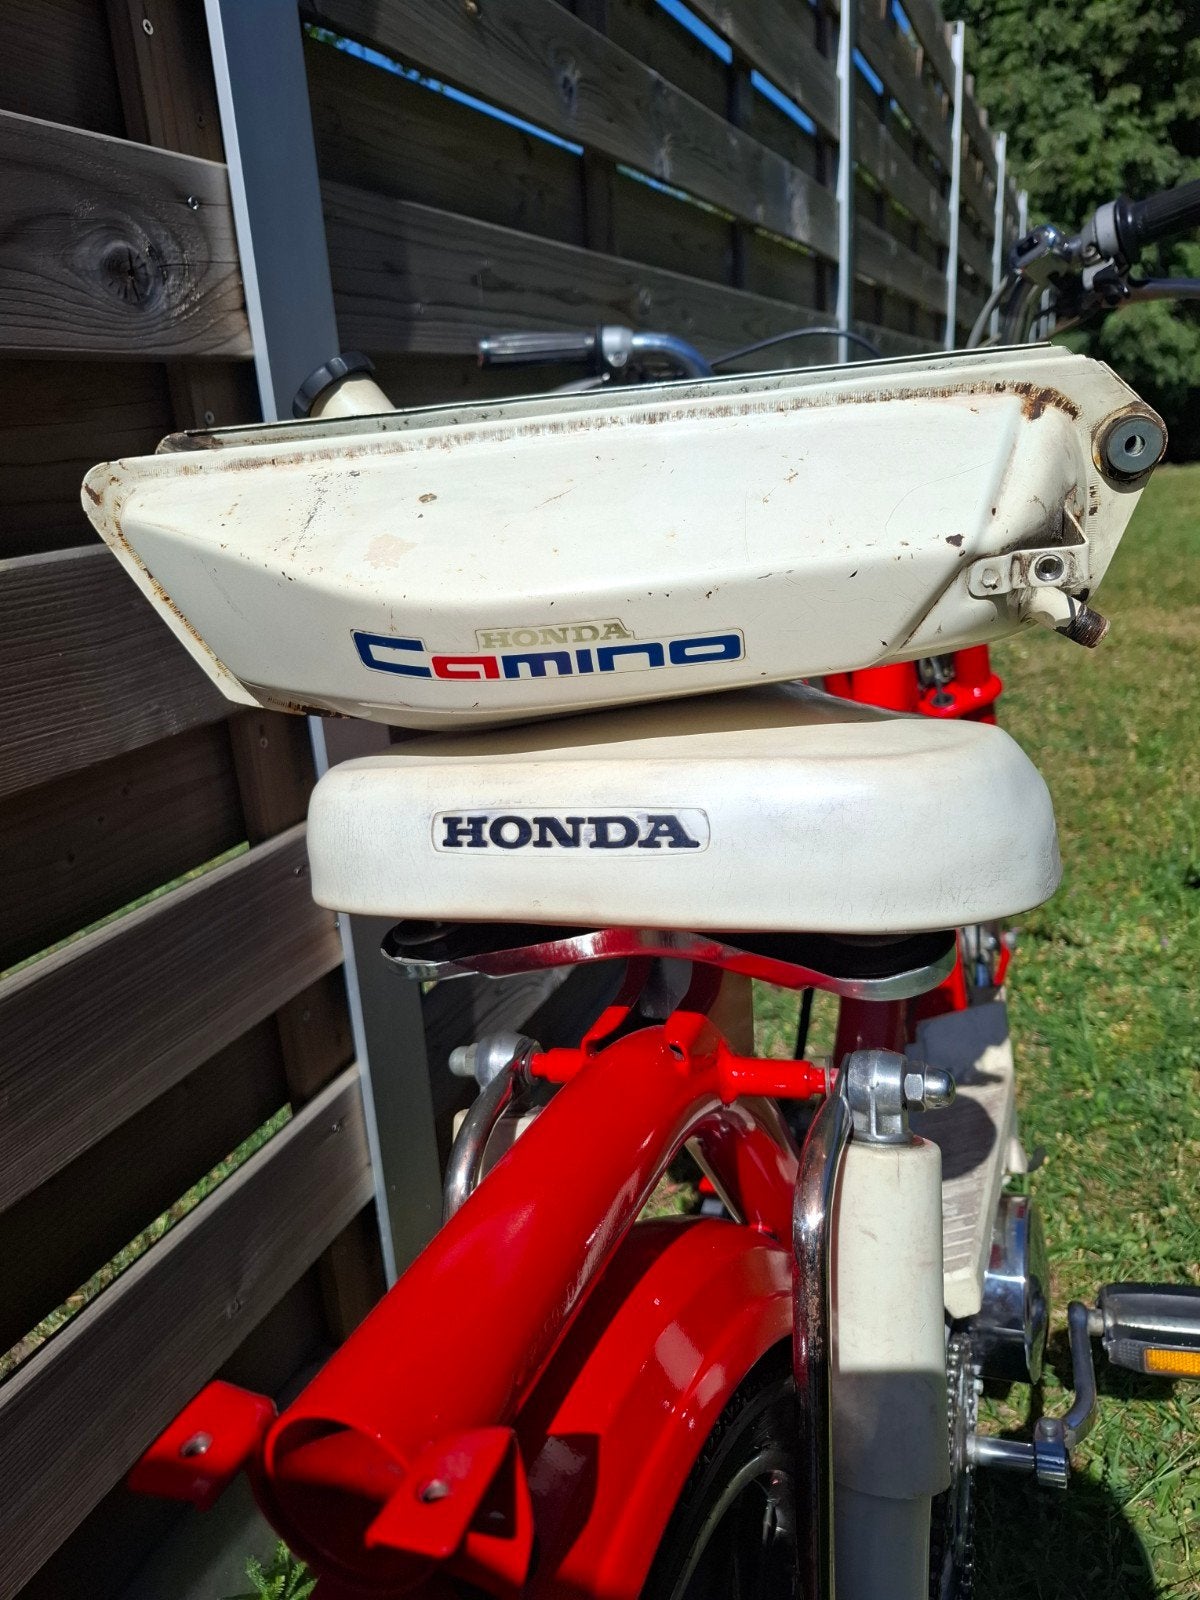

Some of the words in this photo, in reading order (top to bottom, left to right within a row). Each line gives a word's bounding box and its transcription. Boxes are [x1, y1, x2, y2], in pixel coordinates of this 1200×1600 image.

[480, 623, 632, 649] HONDA
[353, 632, 741, 679] Camino
[442, 815, 701, 849] HONDA
